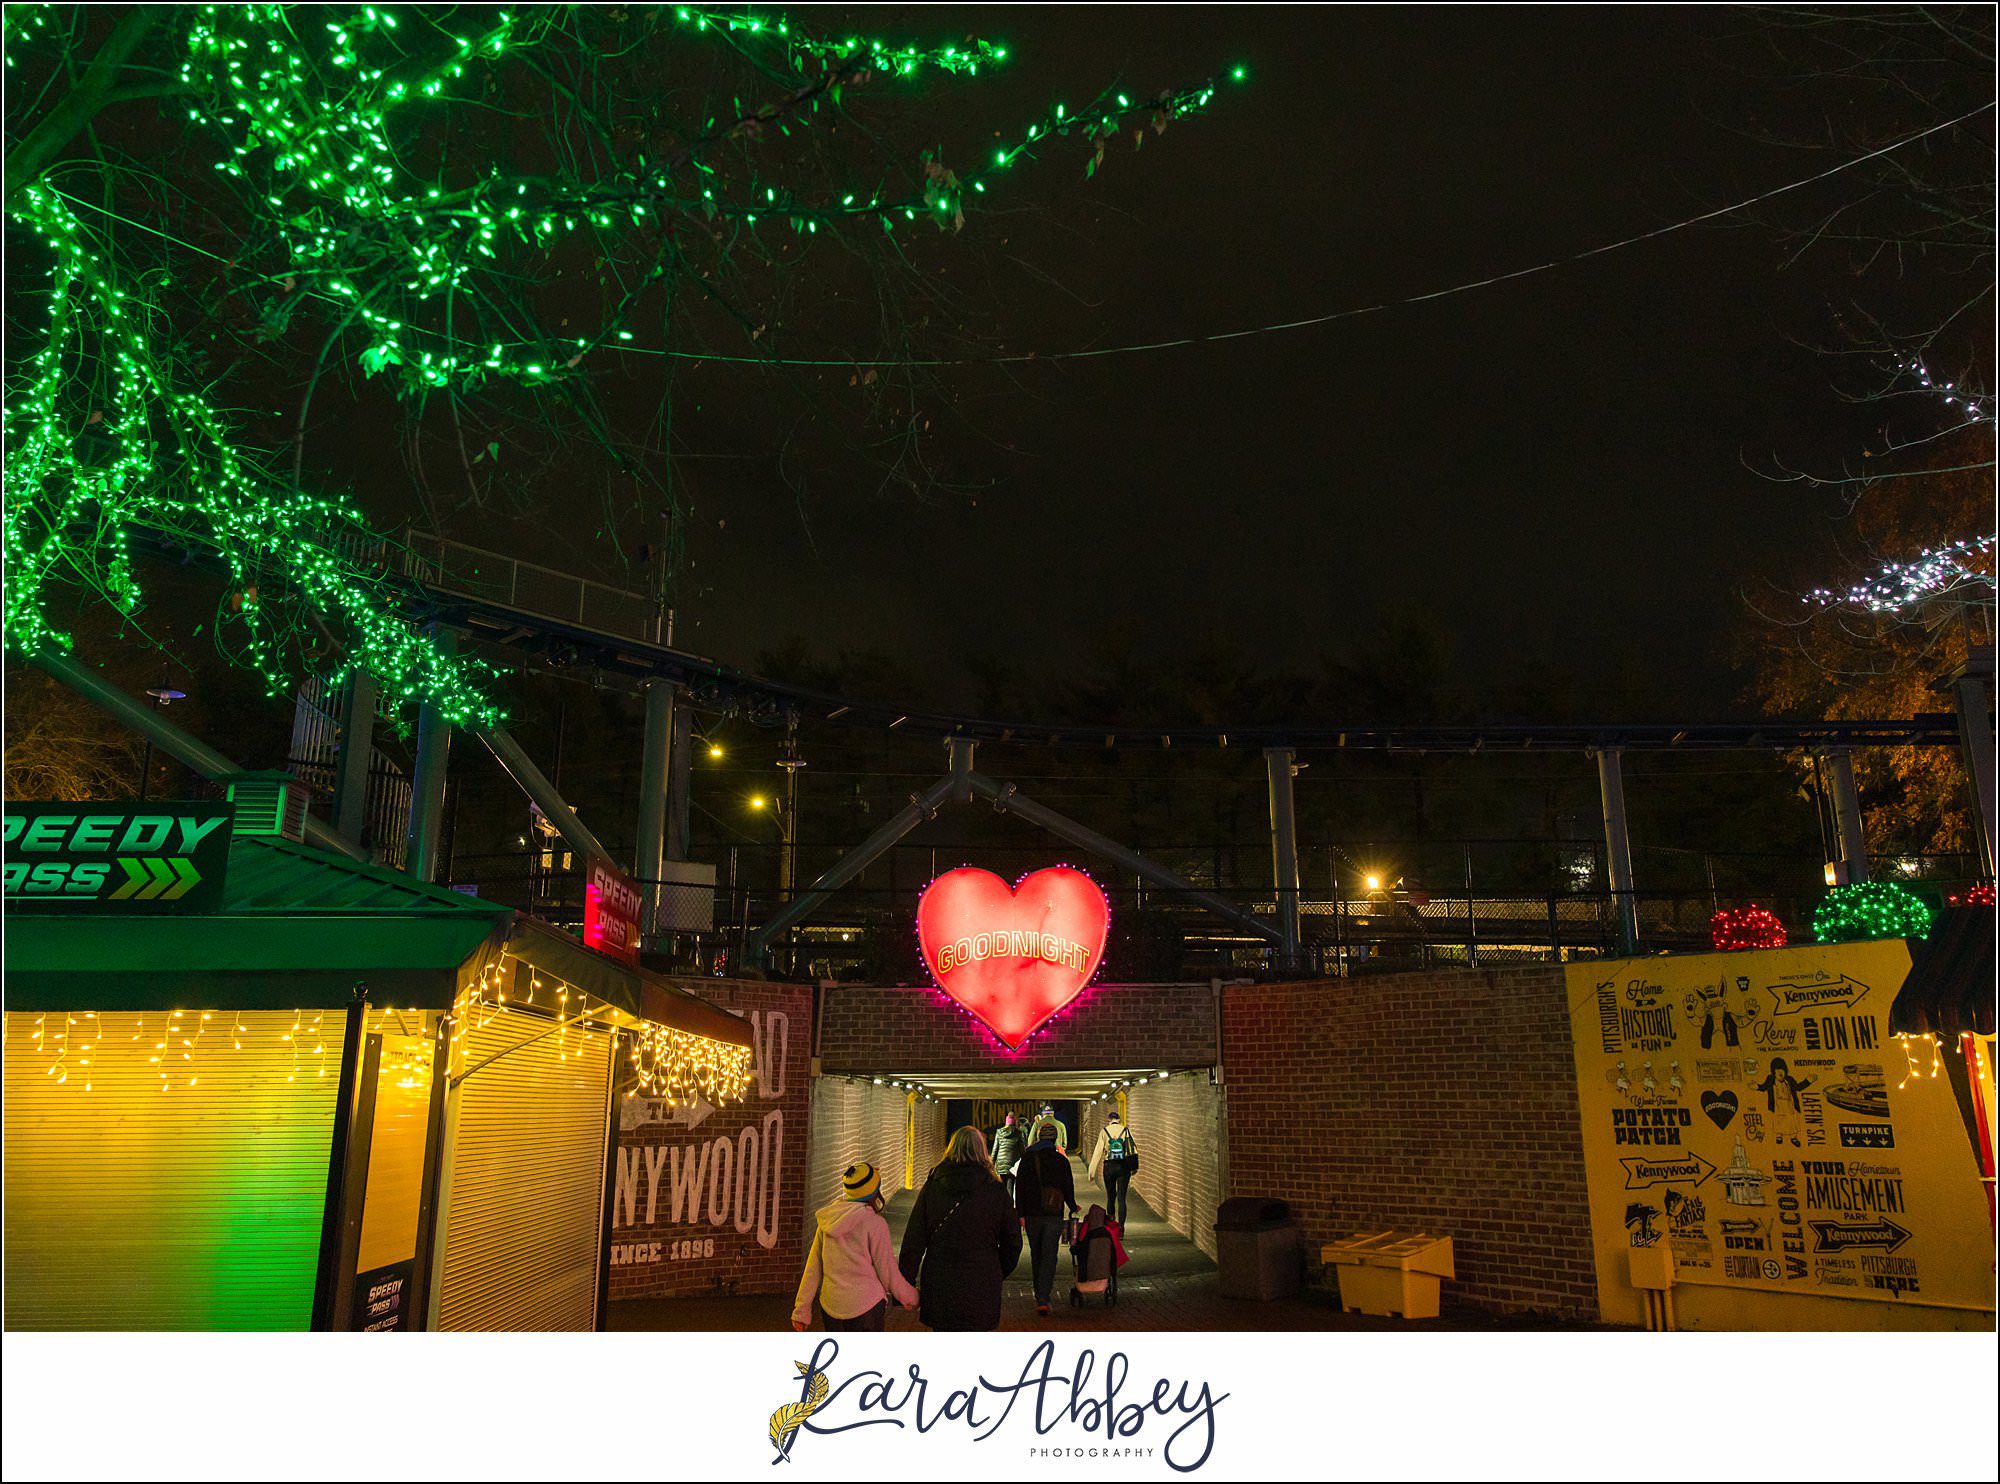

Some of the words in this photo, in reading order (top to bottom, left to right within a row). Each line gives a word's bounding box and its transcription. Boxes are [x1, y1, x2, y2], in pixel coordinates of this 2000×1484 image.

[594, 865, 643, 921] SPEEDY
[599, 909, 627, 943] PASS
[937, 930, 1091, 974] GOODNIGHT
[1626, 980, 1664, 1001] Home
[1783, 984, 1854, 1005] Kennywood
[1620, 1003, 1677, 1041] HISTORIC
[1822, 1016, 1849, 1050] ON
[1851, 1015, 1879, 1050] IN!
[1753, 1020, 1796, 1046] Kenny
[1803, 1018, 1821, 1050] HOP
[1641, 1039, 1662, 1052] FUN
[1612, 1108, 1693, 1127] POTATO
[1743, 1113, 1764, 1127] STEEL
[1615, 1127, 1682, 1145] PATCH
[1807, 1129, 1826, 1147] SAL
[1843, 1126, 1890, 1136] TURNPIKE
[1635, 1162, 1700, 1179] Kennywood
[1801, 1161, 1846, 1176] YOUR
[1806, 1176, 1905, 1214] AMUSEMENT
[1772, 1160, 1808, 1280] WELCOME
[1843, 1212, 1868, 1221] PARK
[1725, 1236, 1764, 1251] OPEN
[1826, 1228, 1894, 1243] Kennywood
[670, 1239, 715, 1260] 1898
[1724, 1256, 1735, 1278] STEEL
[1815, 1257, 1820, 1266] A
[1820, 1258, 1856, 1269] TIMELESS
[1861, 1255, 1918, 1277] PITTSBURGH
[367, 1279, 404, 1303] SPEEDY
[370, 1299, 391, 1315] PASS
